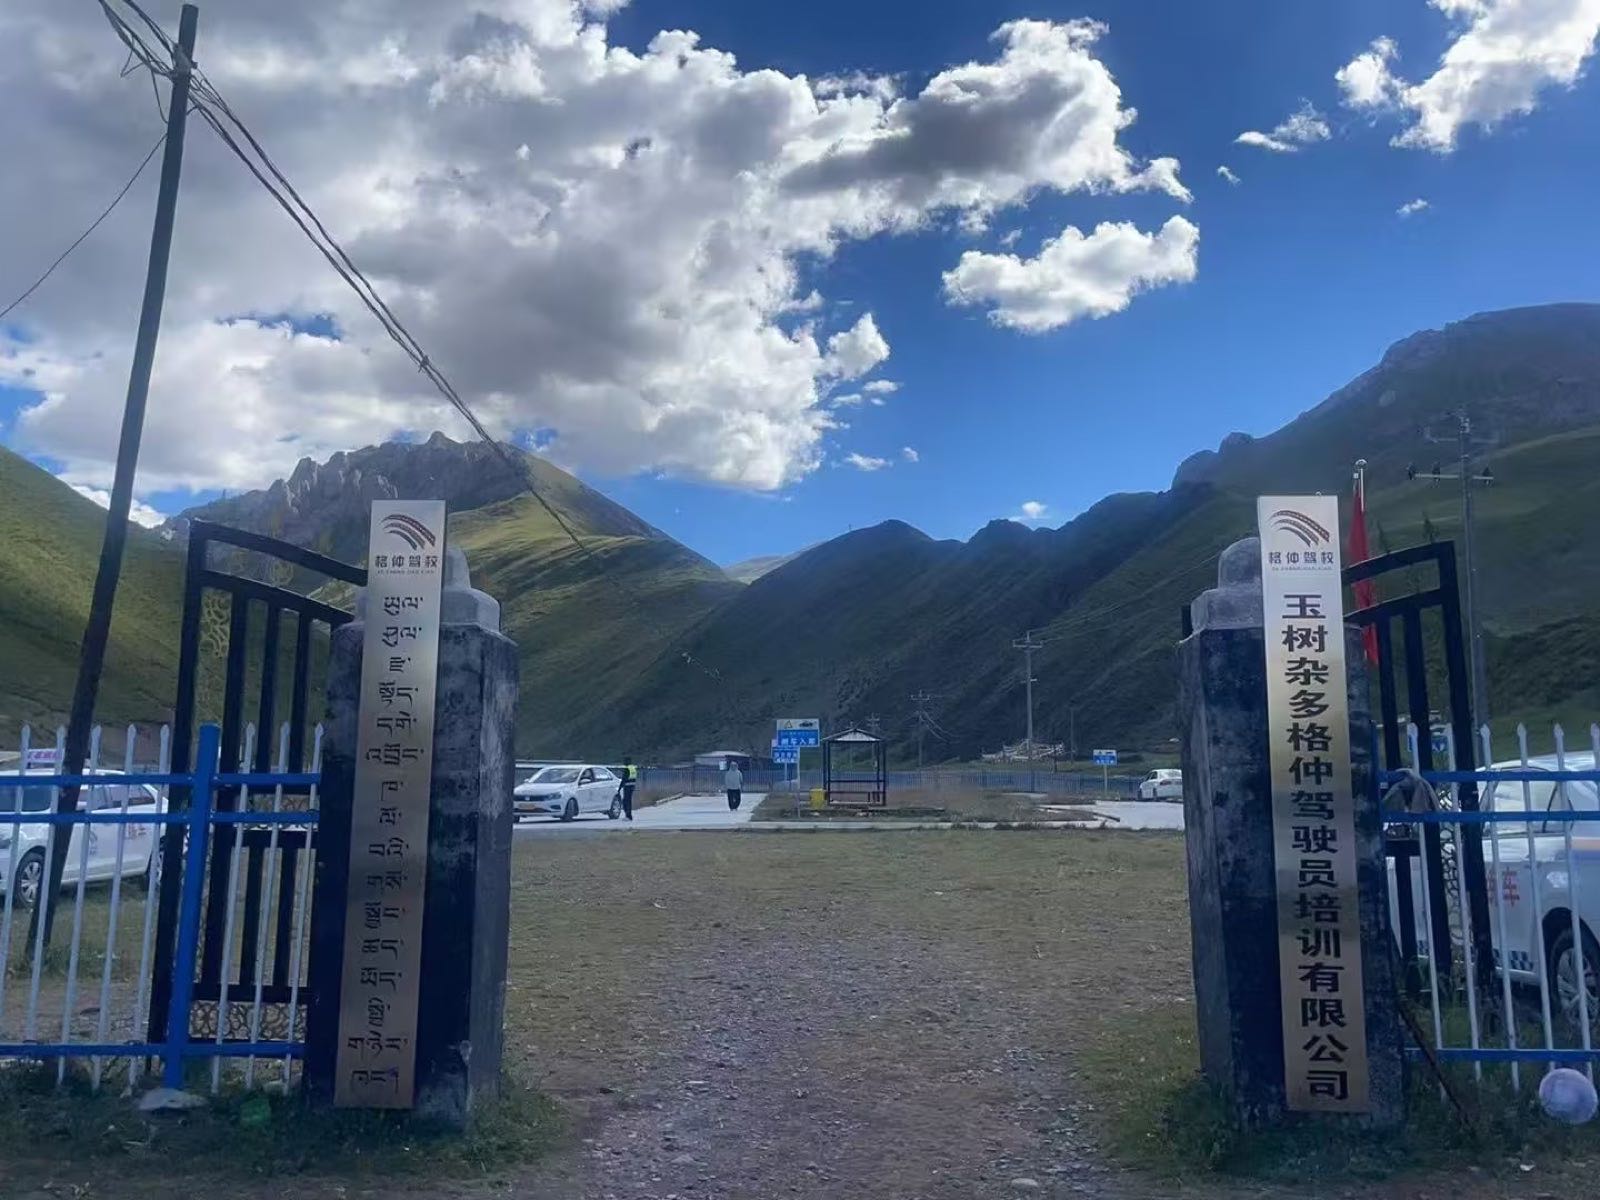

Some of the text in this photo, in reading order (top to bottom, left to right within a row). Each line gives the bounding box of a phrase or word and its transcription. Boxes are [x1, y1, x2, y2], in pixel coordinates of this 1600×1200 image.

[1281, 593, 1351, 1101] 玉树杂多格仲驾驶员培训有限公司
